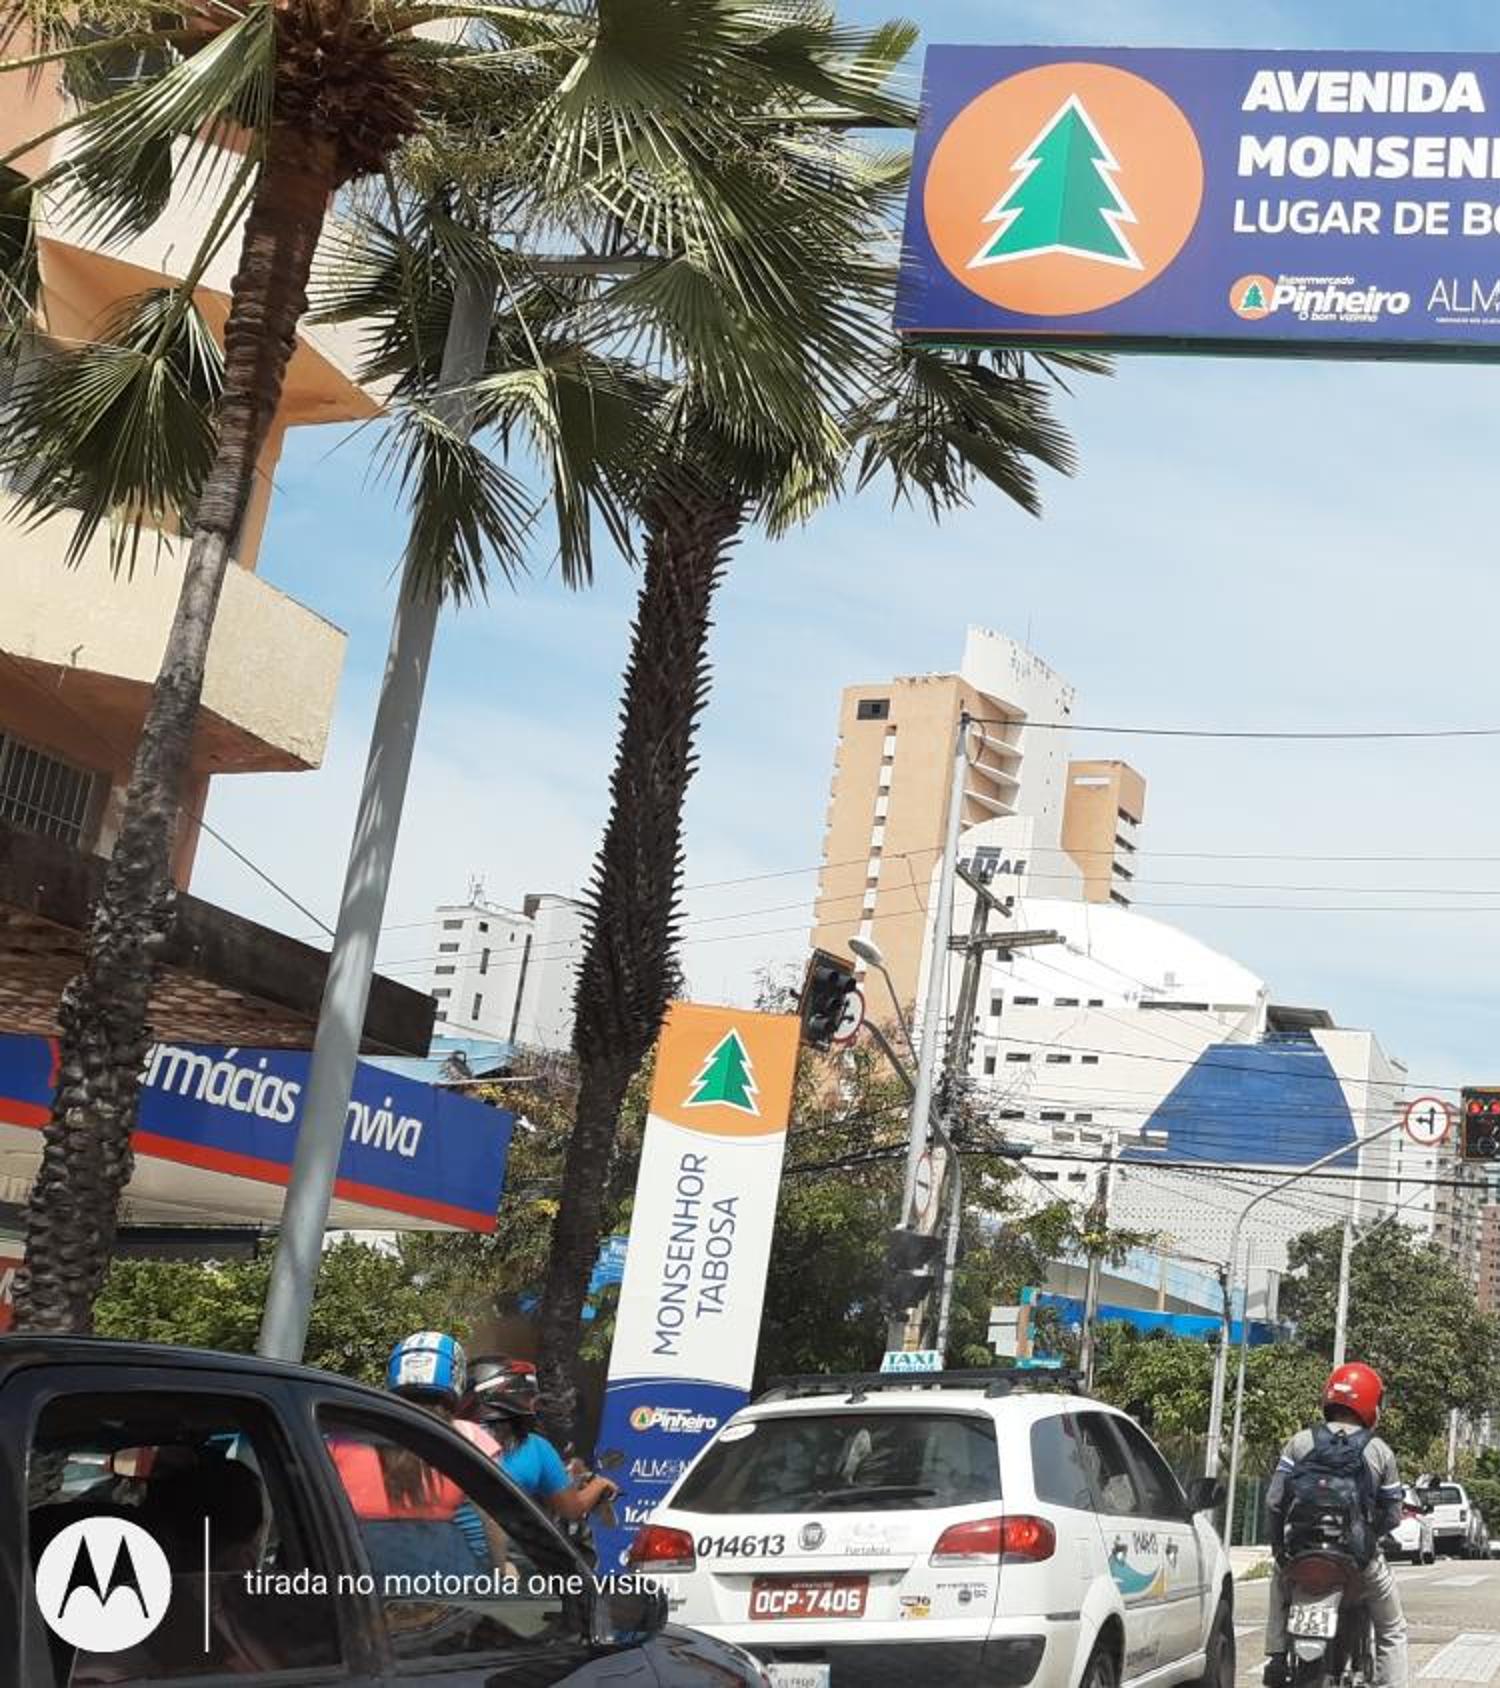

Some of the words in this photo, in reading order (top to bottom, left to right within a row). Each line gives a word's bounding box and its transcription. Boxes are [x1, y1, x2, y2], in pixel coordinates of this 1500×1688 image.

[1242, 71, 1485, 112] AVENIDA
[1234, 199, 1382, 235] LUGAR
[1393, 201, 1450, 235] DE
[1269, 285, 1411, 315] Pinheiro
[652, 1153, 708, 1355] MONSENHOR
[696, 1197, 739, 1319] TABOSA
[888, 1352, 935, 1365] TAXI
[651, 1411, 718, 1431] Pinheiro
[697, 1534, 786, 1558] 014613
